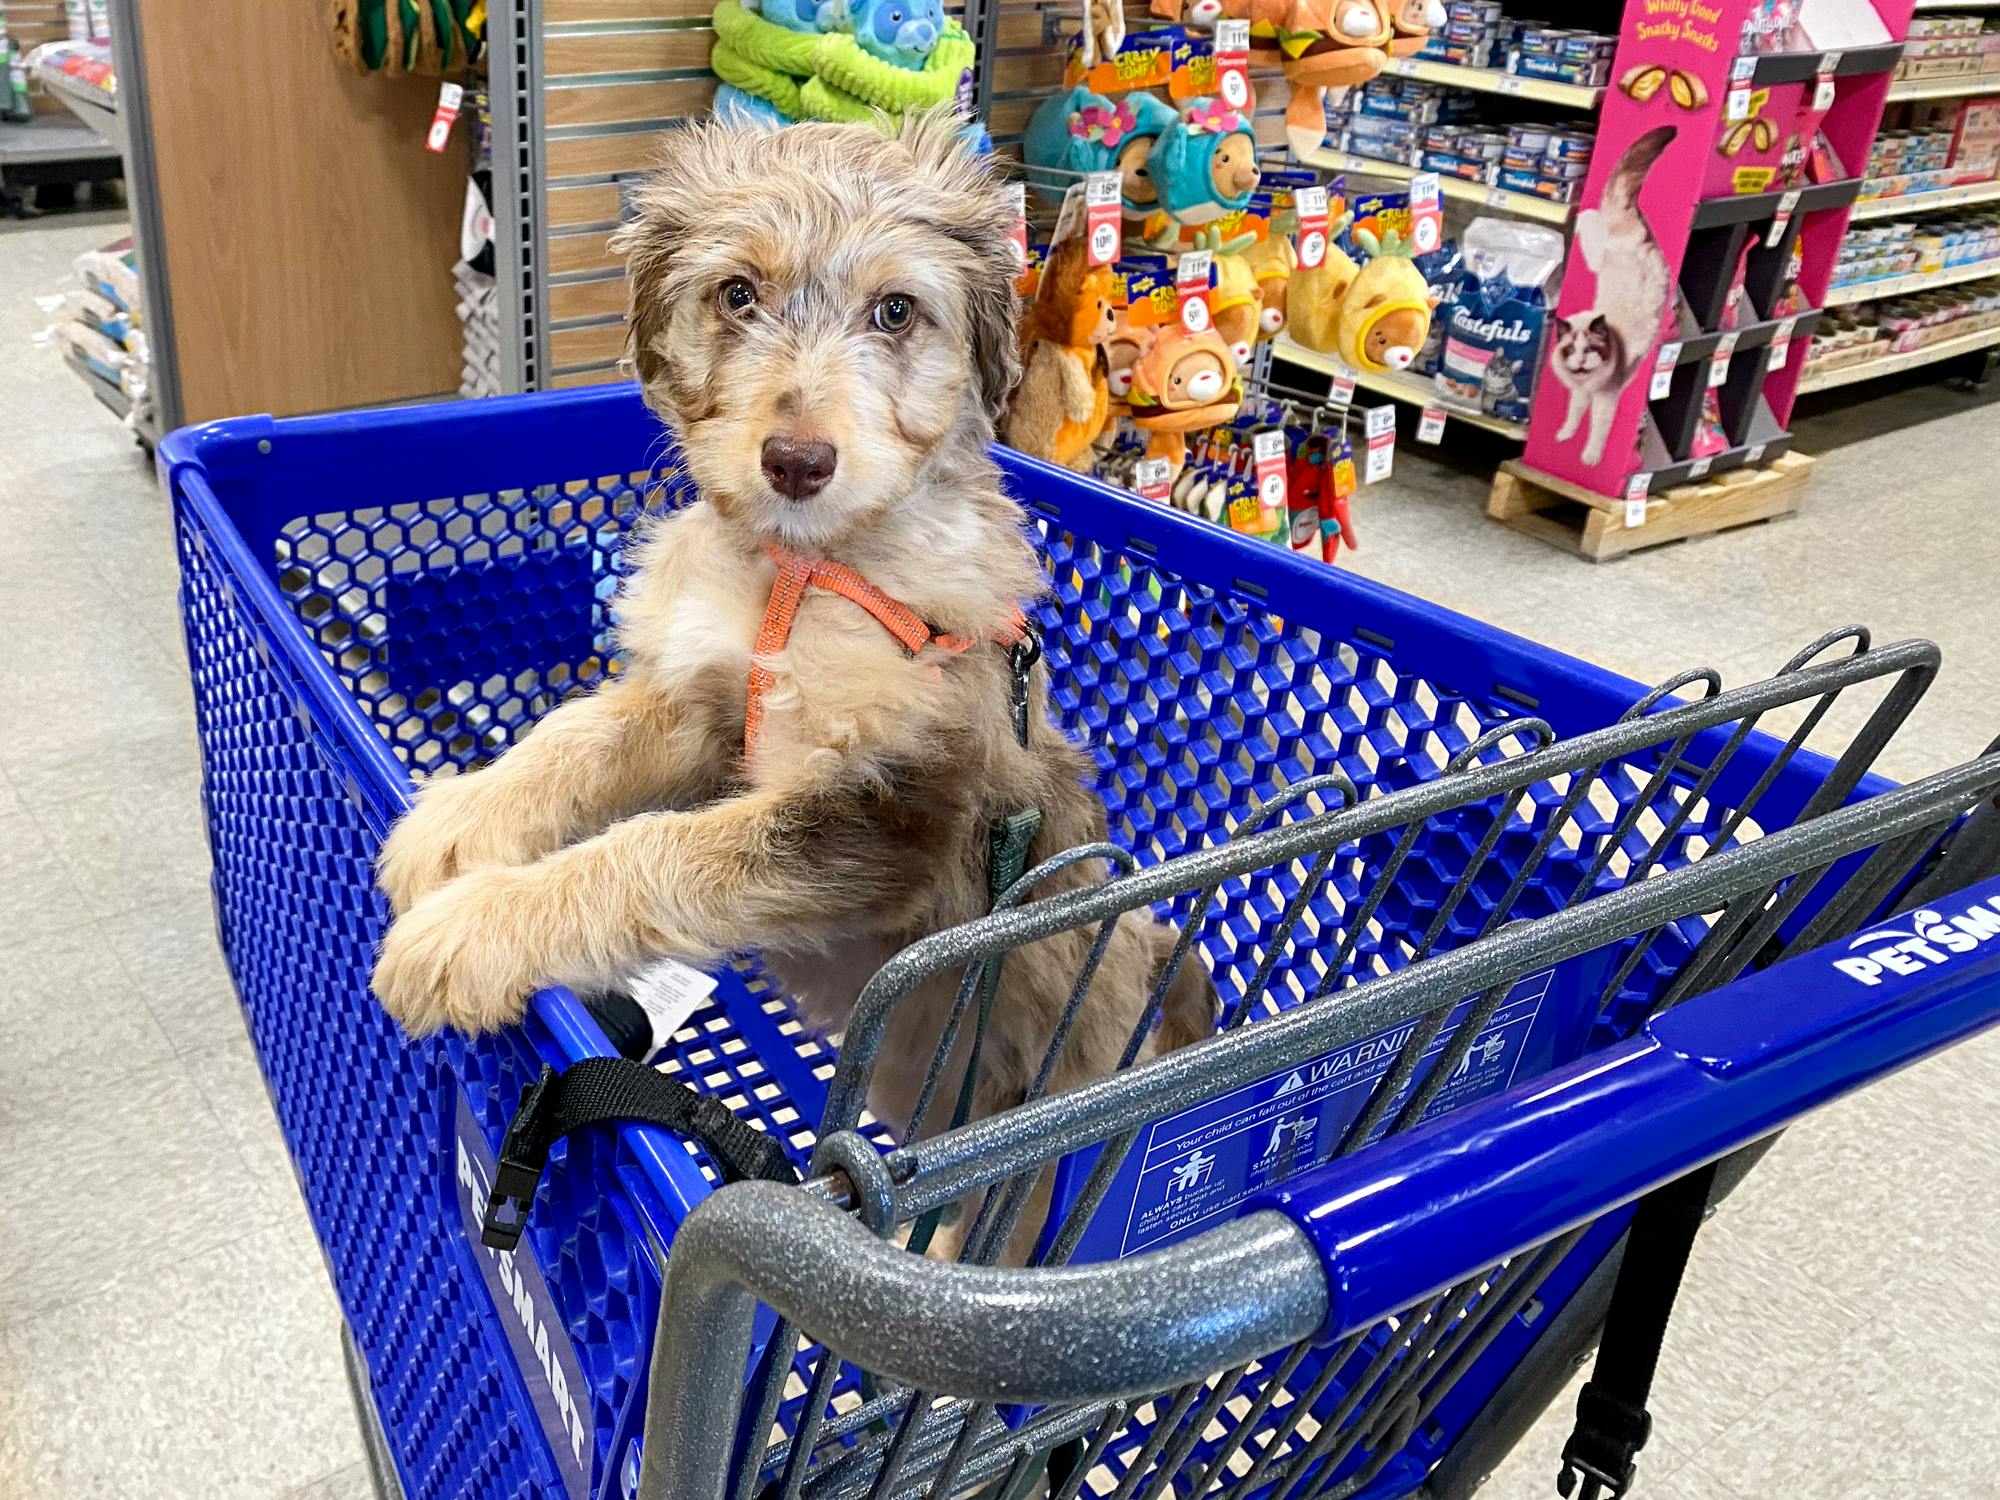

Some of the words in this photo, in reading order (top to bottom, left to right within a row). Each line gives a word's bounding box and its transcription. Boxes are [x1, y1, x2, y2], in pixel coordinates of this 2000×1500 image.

[1636, 19, 1680, 41] Snacky
[1681, 20, 1719, 53] Snacks
[1114, 46, 1160, 67] CRAZY
[1187, 55, 1214, 71] CRAZ
[1117, 63, 1157, 81] COMFY
[1376, 207, 1412, 222] CRAZ
[1149, 285, 1177, 302] CRA
[1153, 300, 1177, 314] COM
[1453, 305, 1532, 343] Tastefuls
[1232, 496, 1259, 510] CRAZ
[1310, 1027, 1414, 1083] WARNI
[1450, 1076, 1468, 1087] NOT
[1176, 1135, 1203, 1151] Your
[1205, 1121, 1233, 1140] child
[1235, 1113, 1256, 1127] can
[1259, 1103, 1275, 1117] fall
[1278, 1096, 1296, 1109] out
[1298, 1089, 1310, 1102] of
[1312, 1082, 1329, 1095] the
[1331, 1074, 1352, 1088] cart
[1354, 1065, 1375, 1079] and
[1252, 1155, 1276, 1170] STAY
[1139, 1214, 1159, 1228] child
[1171, 1202, 1188, 1214] cart
[1189, 1193, 1207, 1207] seat
[1209, 1184, 1225, 1197] and
[1141, 1195, 1182, 1220] ALWAYS
[1184, 1184, 1212, 1200] buckle
[1214, 1178, 1225, 1189] up
[1169, 1211, 1199, 1230] ONLY
[1202, 1203, 1220, 1215] use
[1222, 1194, 1240, 1207] cart
[1241, 1183, 1263, 1199] seat
[1264, 1176, 1279, 1189] for
[1137, 1220, 1163, 1235] fasten
[1166, 1203, 1201, 1225] securely
[457, 1136, 585, 1466] PESMART
